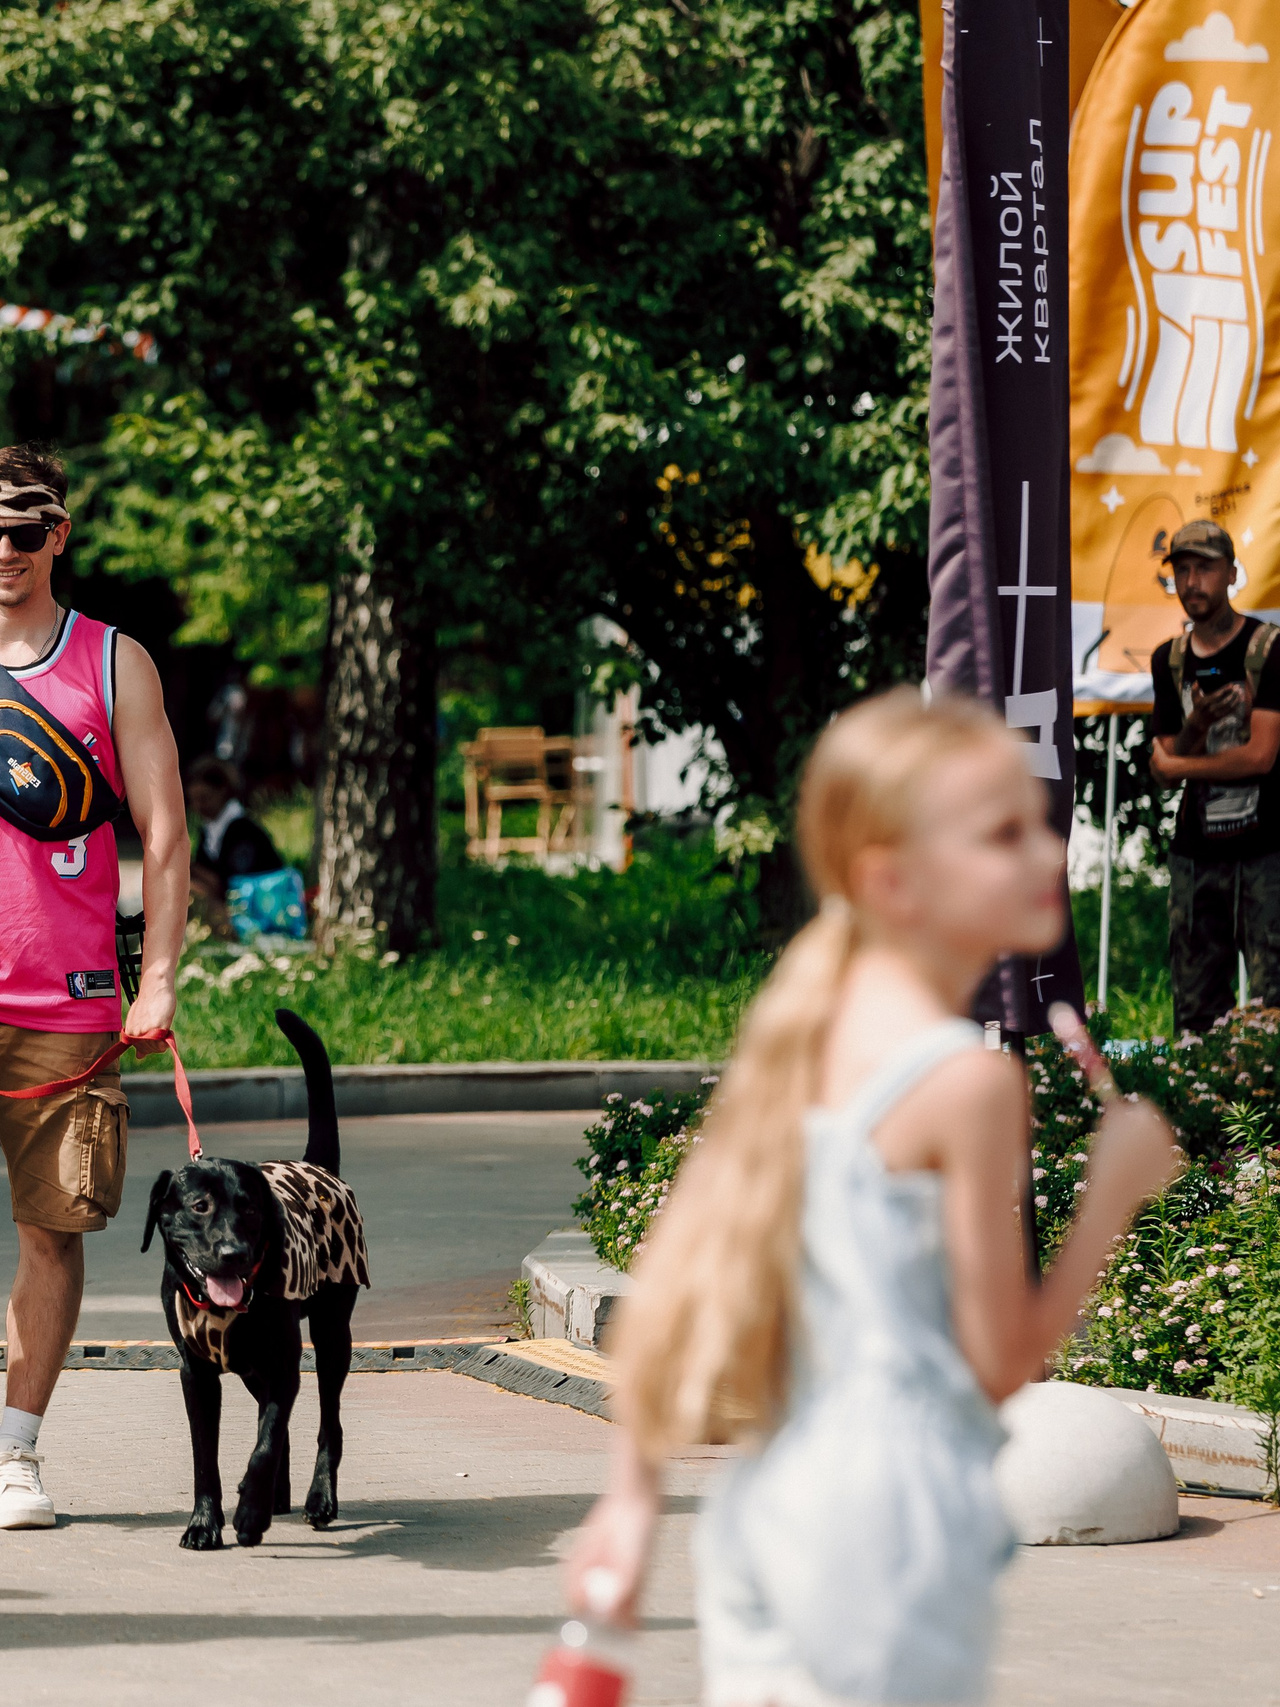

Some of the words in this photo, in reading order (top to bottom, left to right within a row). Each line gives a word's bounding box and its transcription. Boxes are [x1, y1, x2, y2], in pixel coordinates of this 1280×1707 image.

[989, 172, 1022, 364] ЖИЛОЙ
[1138, 81, 1202, 273] SUP
[1197, 86, 1252, 277] FEST
